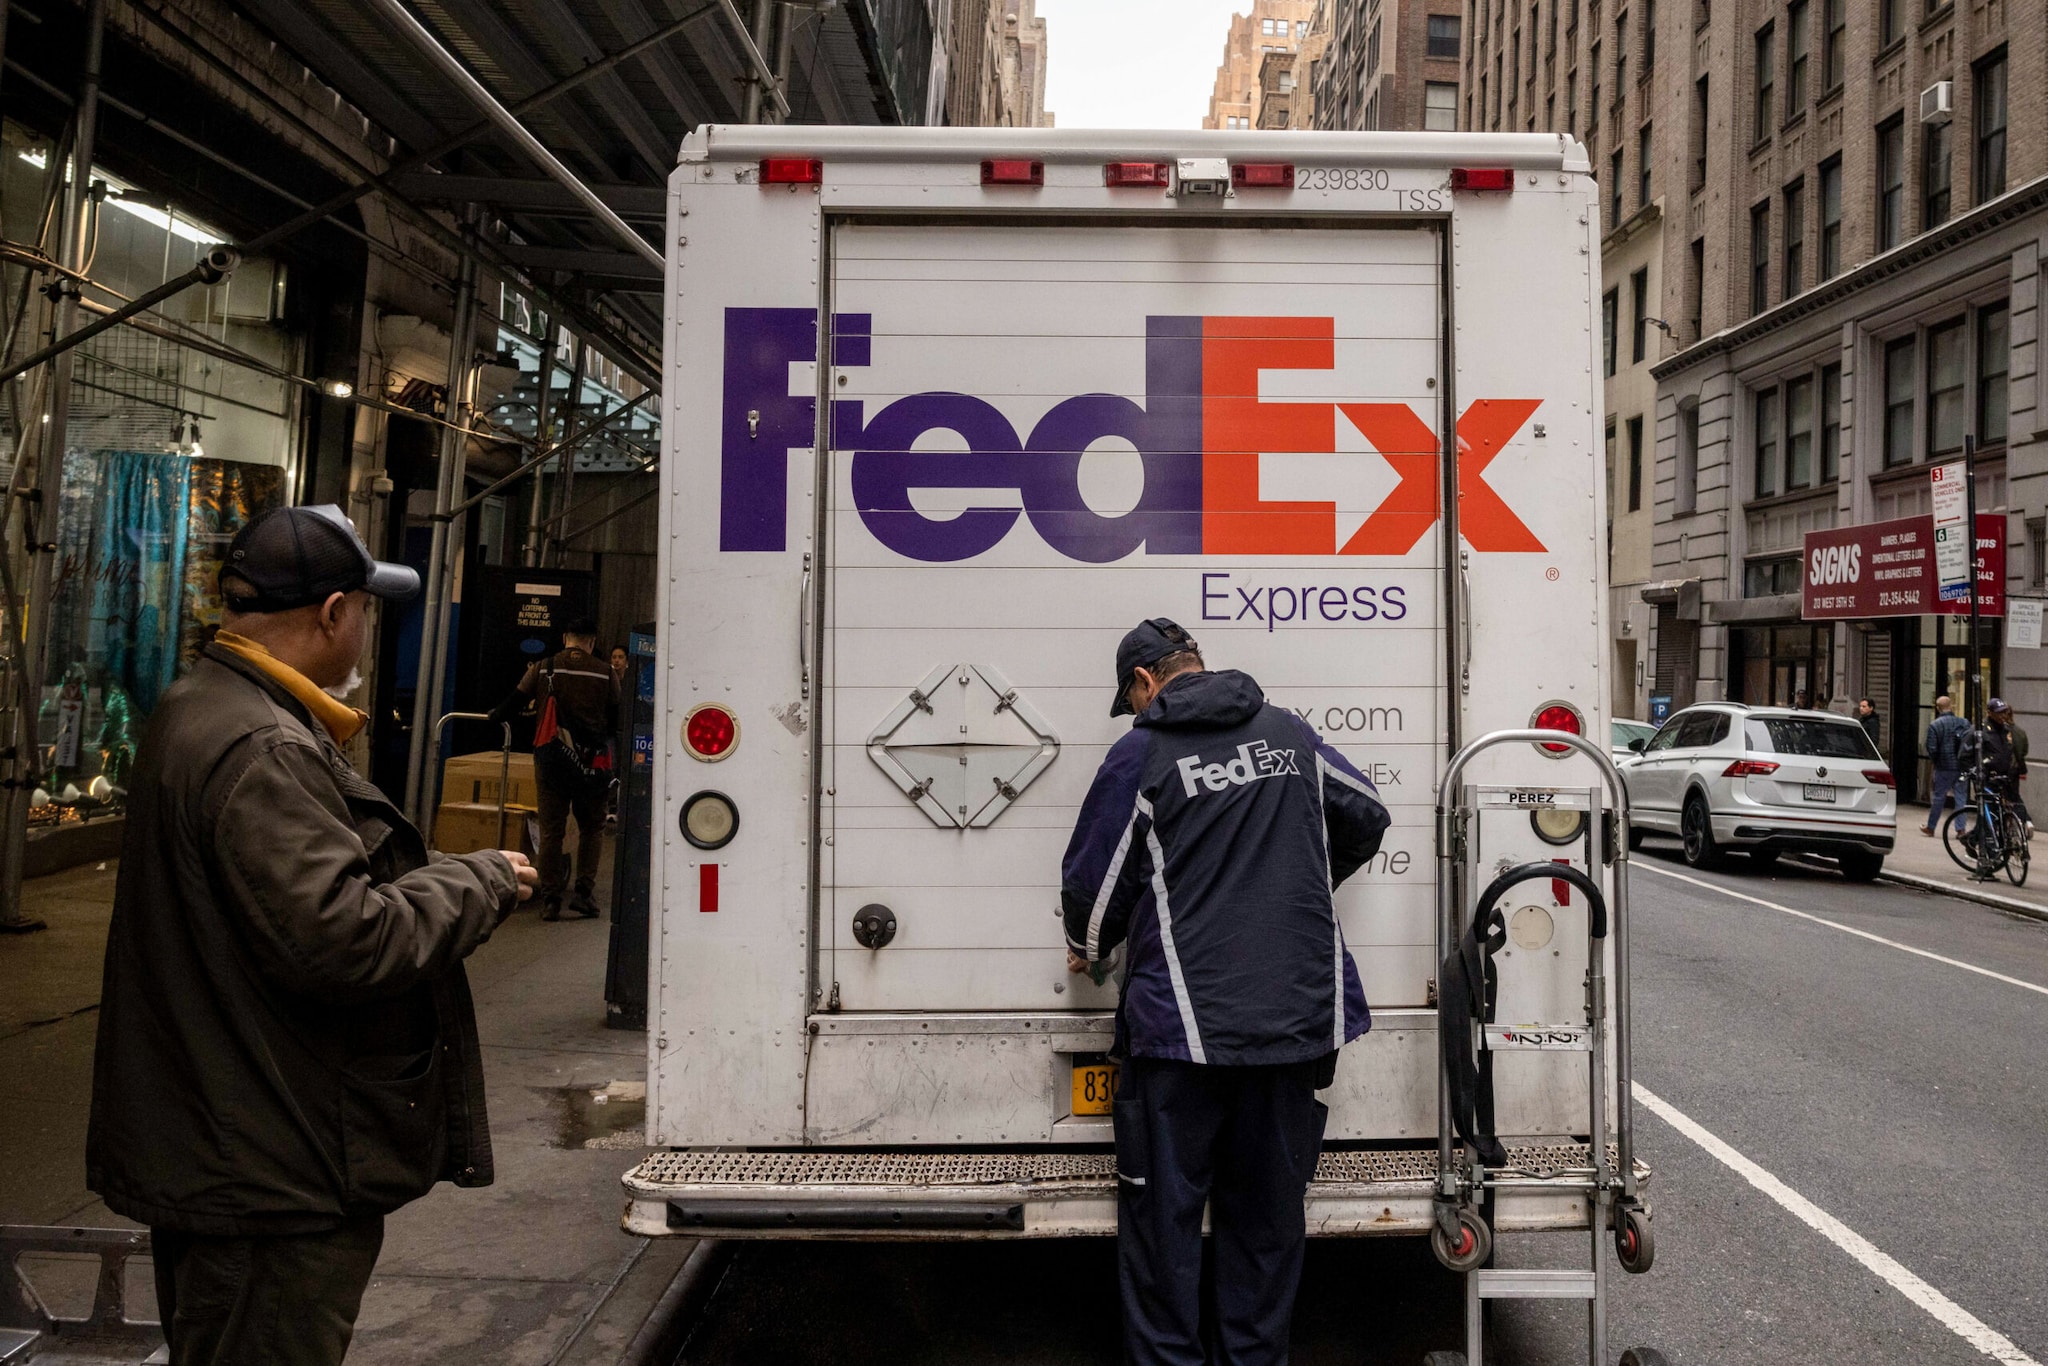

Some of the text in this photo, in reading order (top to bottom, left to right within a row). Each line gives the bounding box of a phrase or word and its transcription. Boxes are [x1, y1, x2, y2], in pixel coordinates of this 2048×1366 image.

[1298, 168, 1389, 190] 239830
[1392, 189, 1442, 211] TSS
[719, 307, 1549, 564] FedEx
[1934, 470, 1941, 480] 3
[1938, 529, 1945, 541] 6
[1810, 544, 1861, 586] SIGNS
[1202, 573, 1407, 632] Express
[1295, 707, 1403, 732] x.com
[1658, 704, 1666, 716] P
[1176, 739, 1300, 799] FedEx
[1360, 763, 1401, 785] dEx
[1510, 793, 1554, 803] PEREZ
